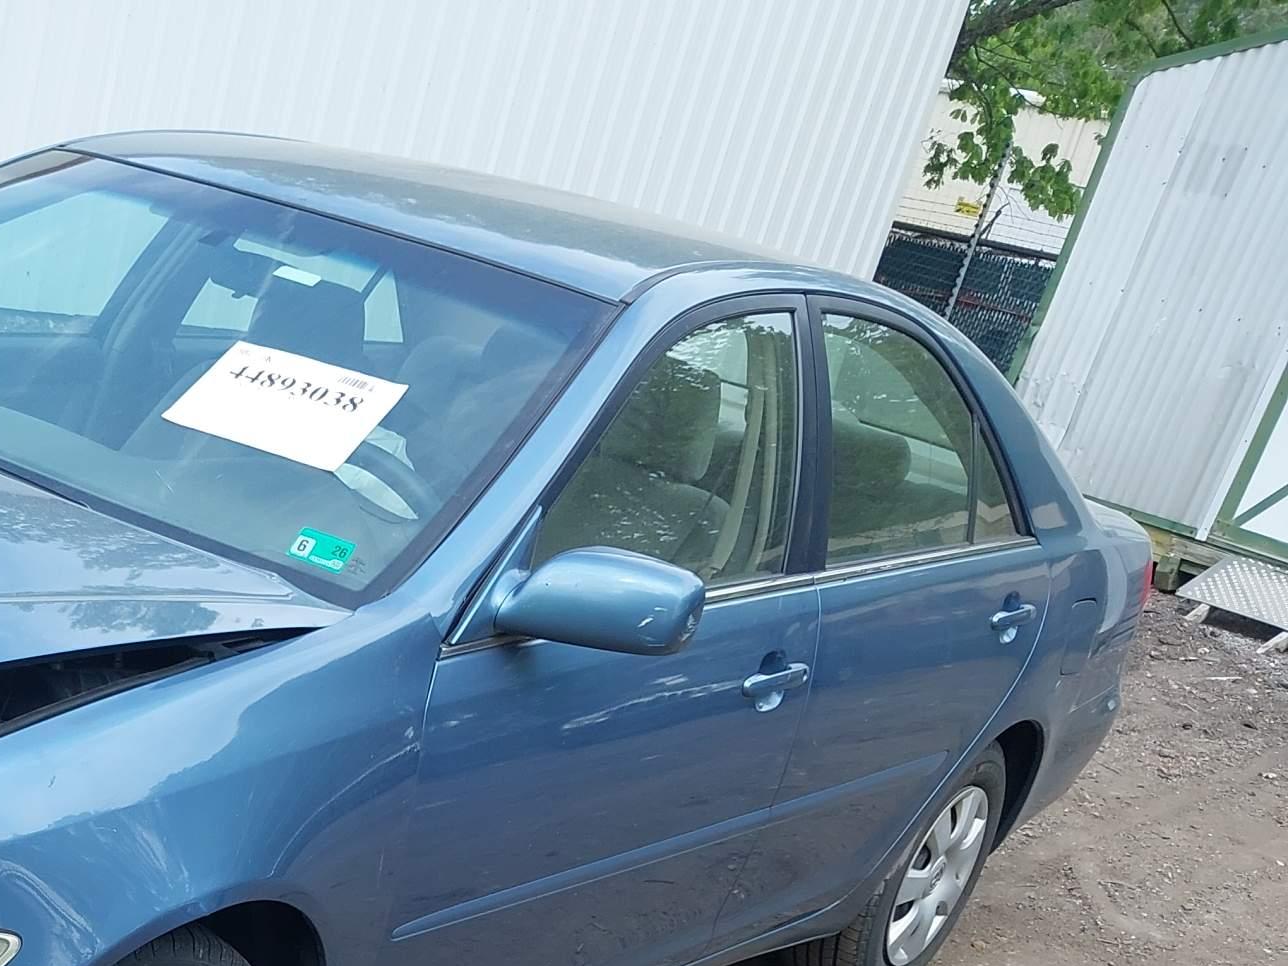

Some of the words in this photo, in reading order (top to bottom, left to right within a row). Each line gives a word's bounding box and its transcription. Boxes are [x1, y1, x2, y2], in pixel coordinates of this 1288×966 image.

[229, 366, 364, 412] 44893038
[297, 539, 309, 552] 6
[332, 545, 349, 559] 26
